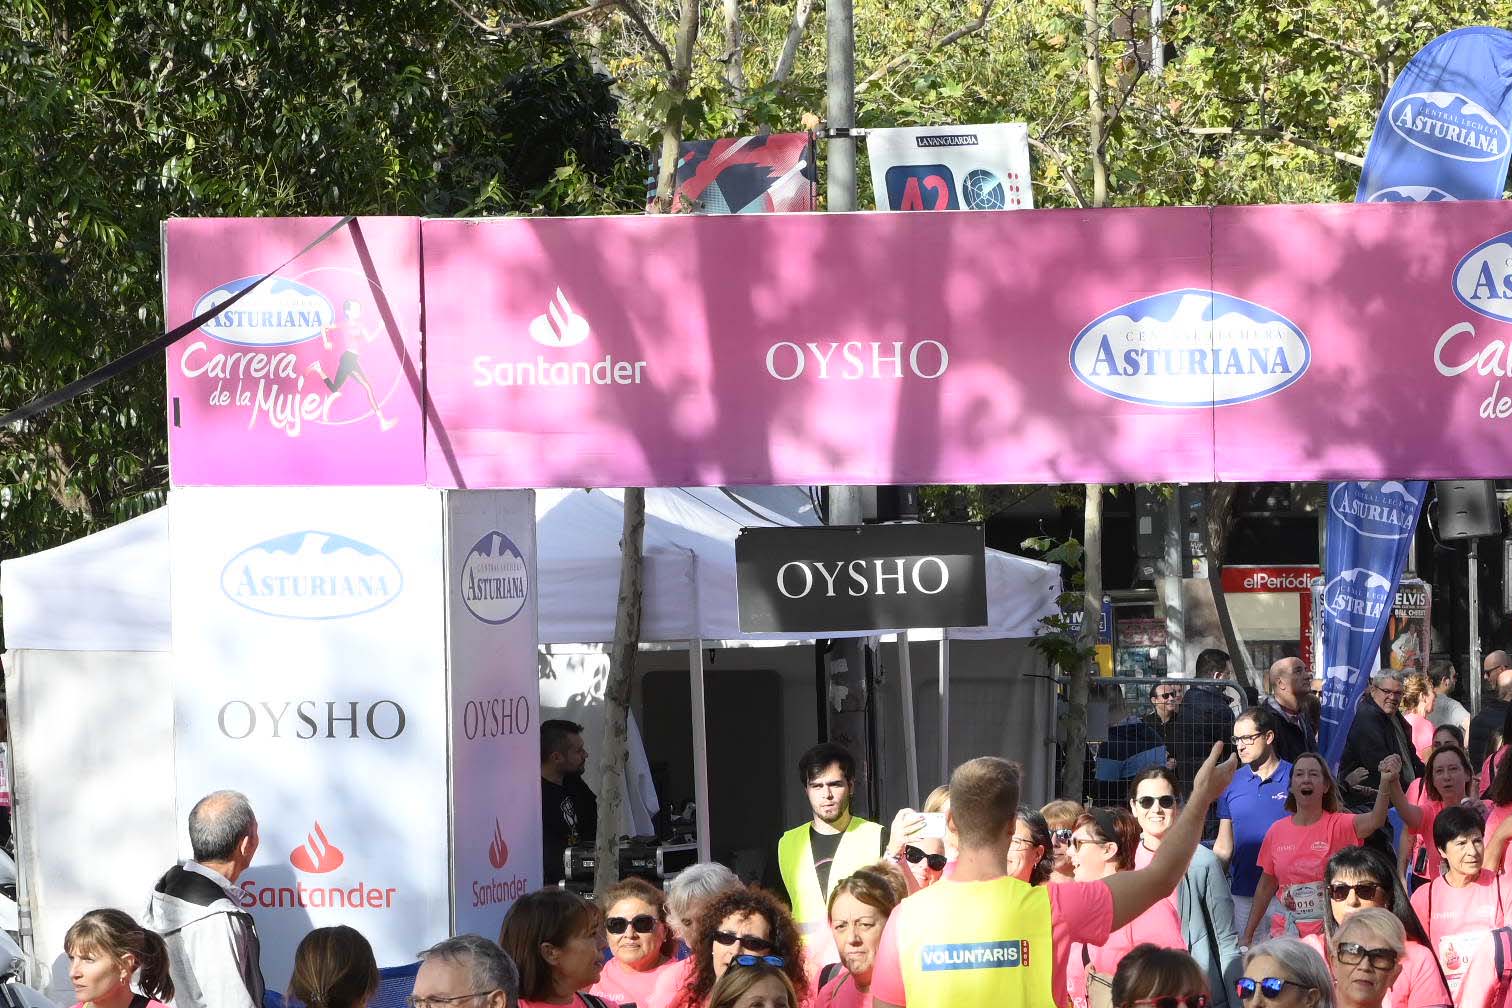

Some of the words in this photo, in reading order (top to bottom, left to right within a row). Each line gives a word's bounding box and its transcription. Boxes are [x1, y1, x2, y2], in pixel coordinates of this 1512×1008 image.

[1396, 108, 1501, 155] ASTURIANA
[204, 299, 323, 330] ASTURIANA
[181, 342, 299, 383] Carrera
[473, 354, 647, 387] Santander
[765, 339, 949, 381] OYSHO
[1089, 333, 1292, 376] ASTURIANA
[209, 381, 232, 407] de
[235, 381, 251, 407] la
[249, 376, 341, 437] Mujer
[236, 566, 388, 598] ASTURIANA
[466, 566, 525, 601] ASTURIANA
[776, 556, 950, 599] OYSHO
[1395, 593, 1426, 606] ELVIS
[217, 699, 406, 739] OYSHO
[464, 696, 530, 740] OYSHO
[241, 881, 397, 909] Santander
[472, 873, 528, 908] Santander
[921, 948, 1018, 965] VOLUNTARIS
